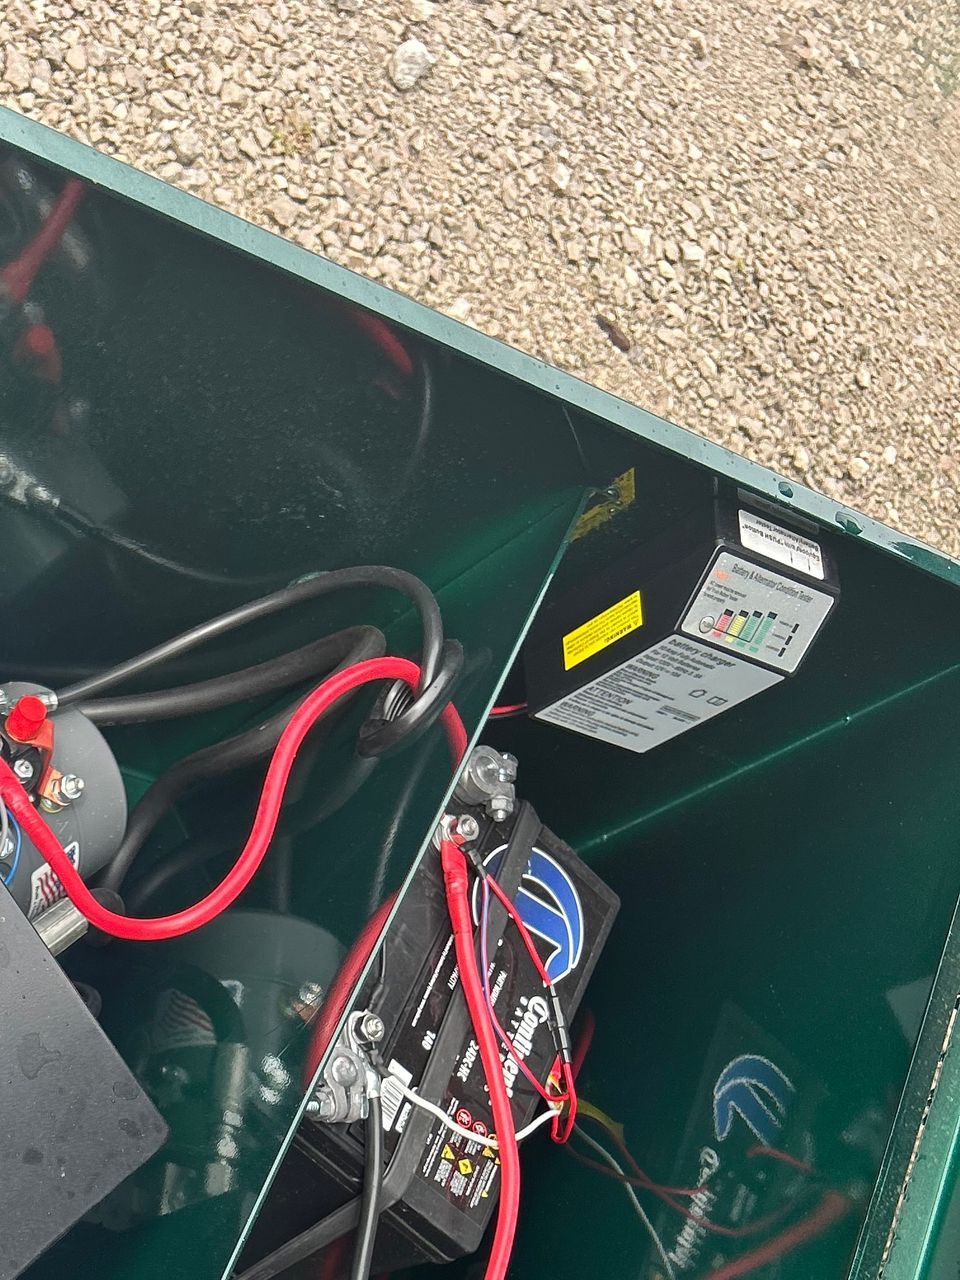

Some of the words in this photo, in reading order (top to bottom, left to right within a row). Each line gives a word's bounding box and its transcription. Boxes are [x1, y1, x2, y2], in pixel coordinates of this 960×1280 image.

[730, 563, 751, 578] Battery
[665, 638, 704, 655] battery
[697, 651, 737, 669] charger
[421, 1030, 437, 1051] 140
[457, 1039, 480, 1083] 24DC-HC
